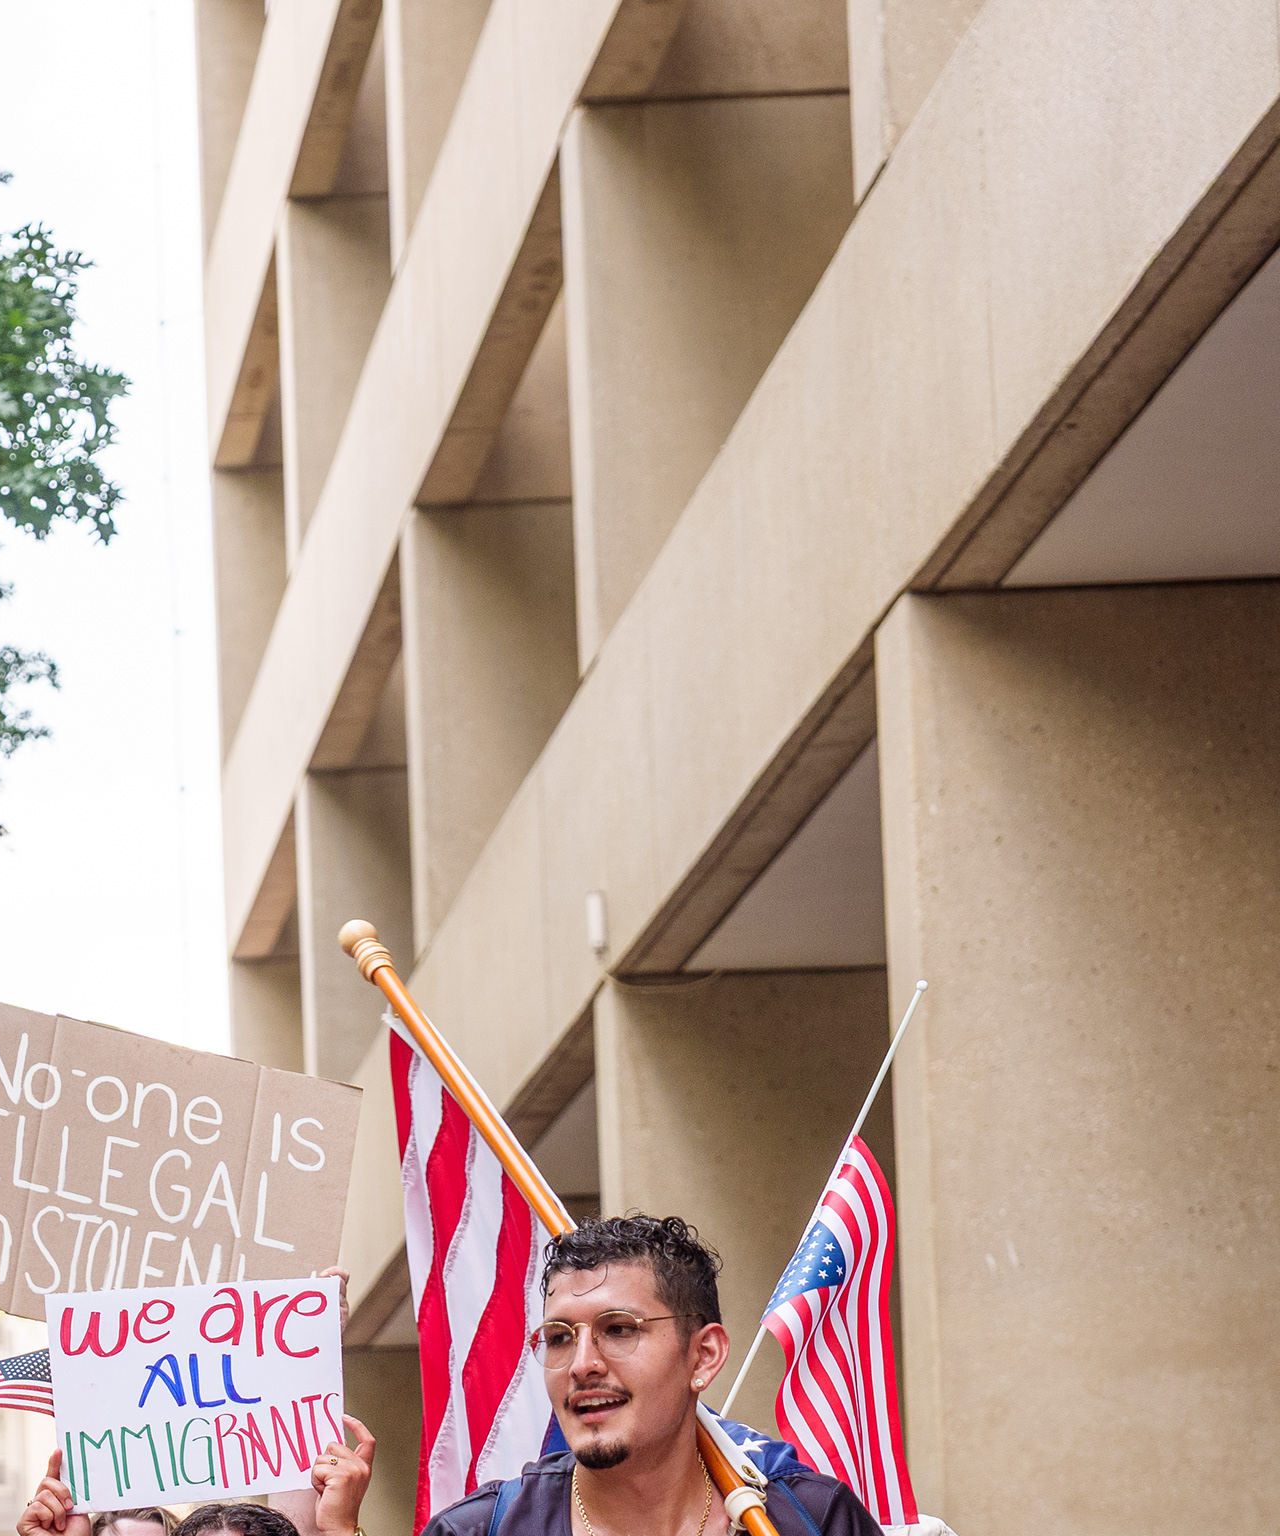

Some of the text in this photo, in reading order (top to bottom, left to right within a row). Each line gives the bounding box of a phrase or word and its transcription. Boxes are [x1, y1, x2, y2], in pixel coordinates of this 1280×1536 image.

[25, 1205, 222, 1295] STOLEN
[199, 1286, 328, 1359] are
[138, 1352, 262, 1409] ALL
[65, 1392, 346, 1506] IMMIGRANTS
